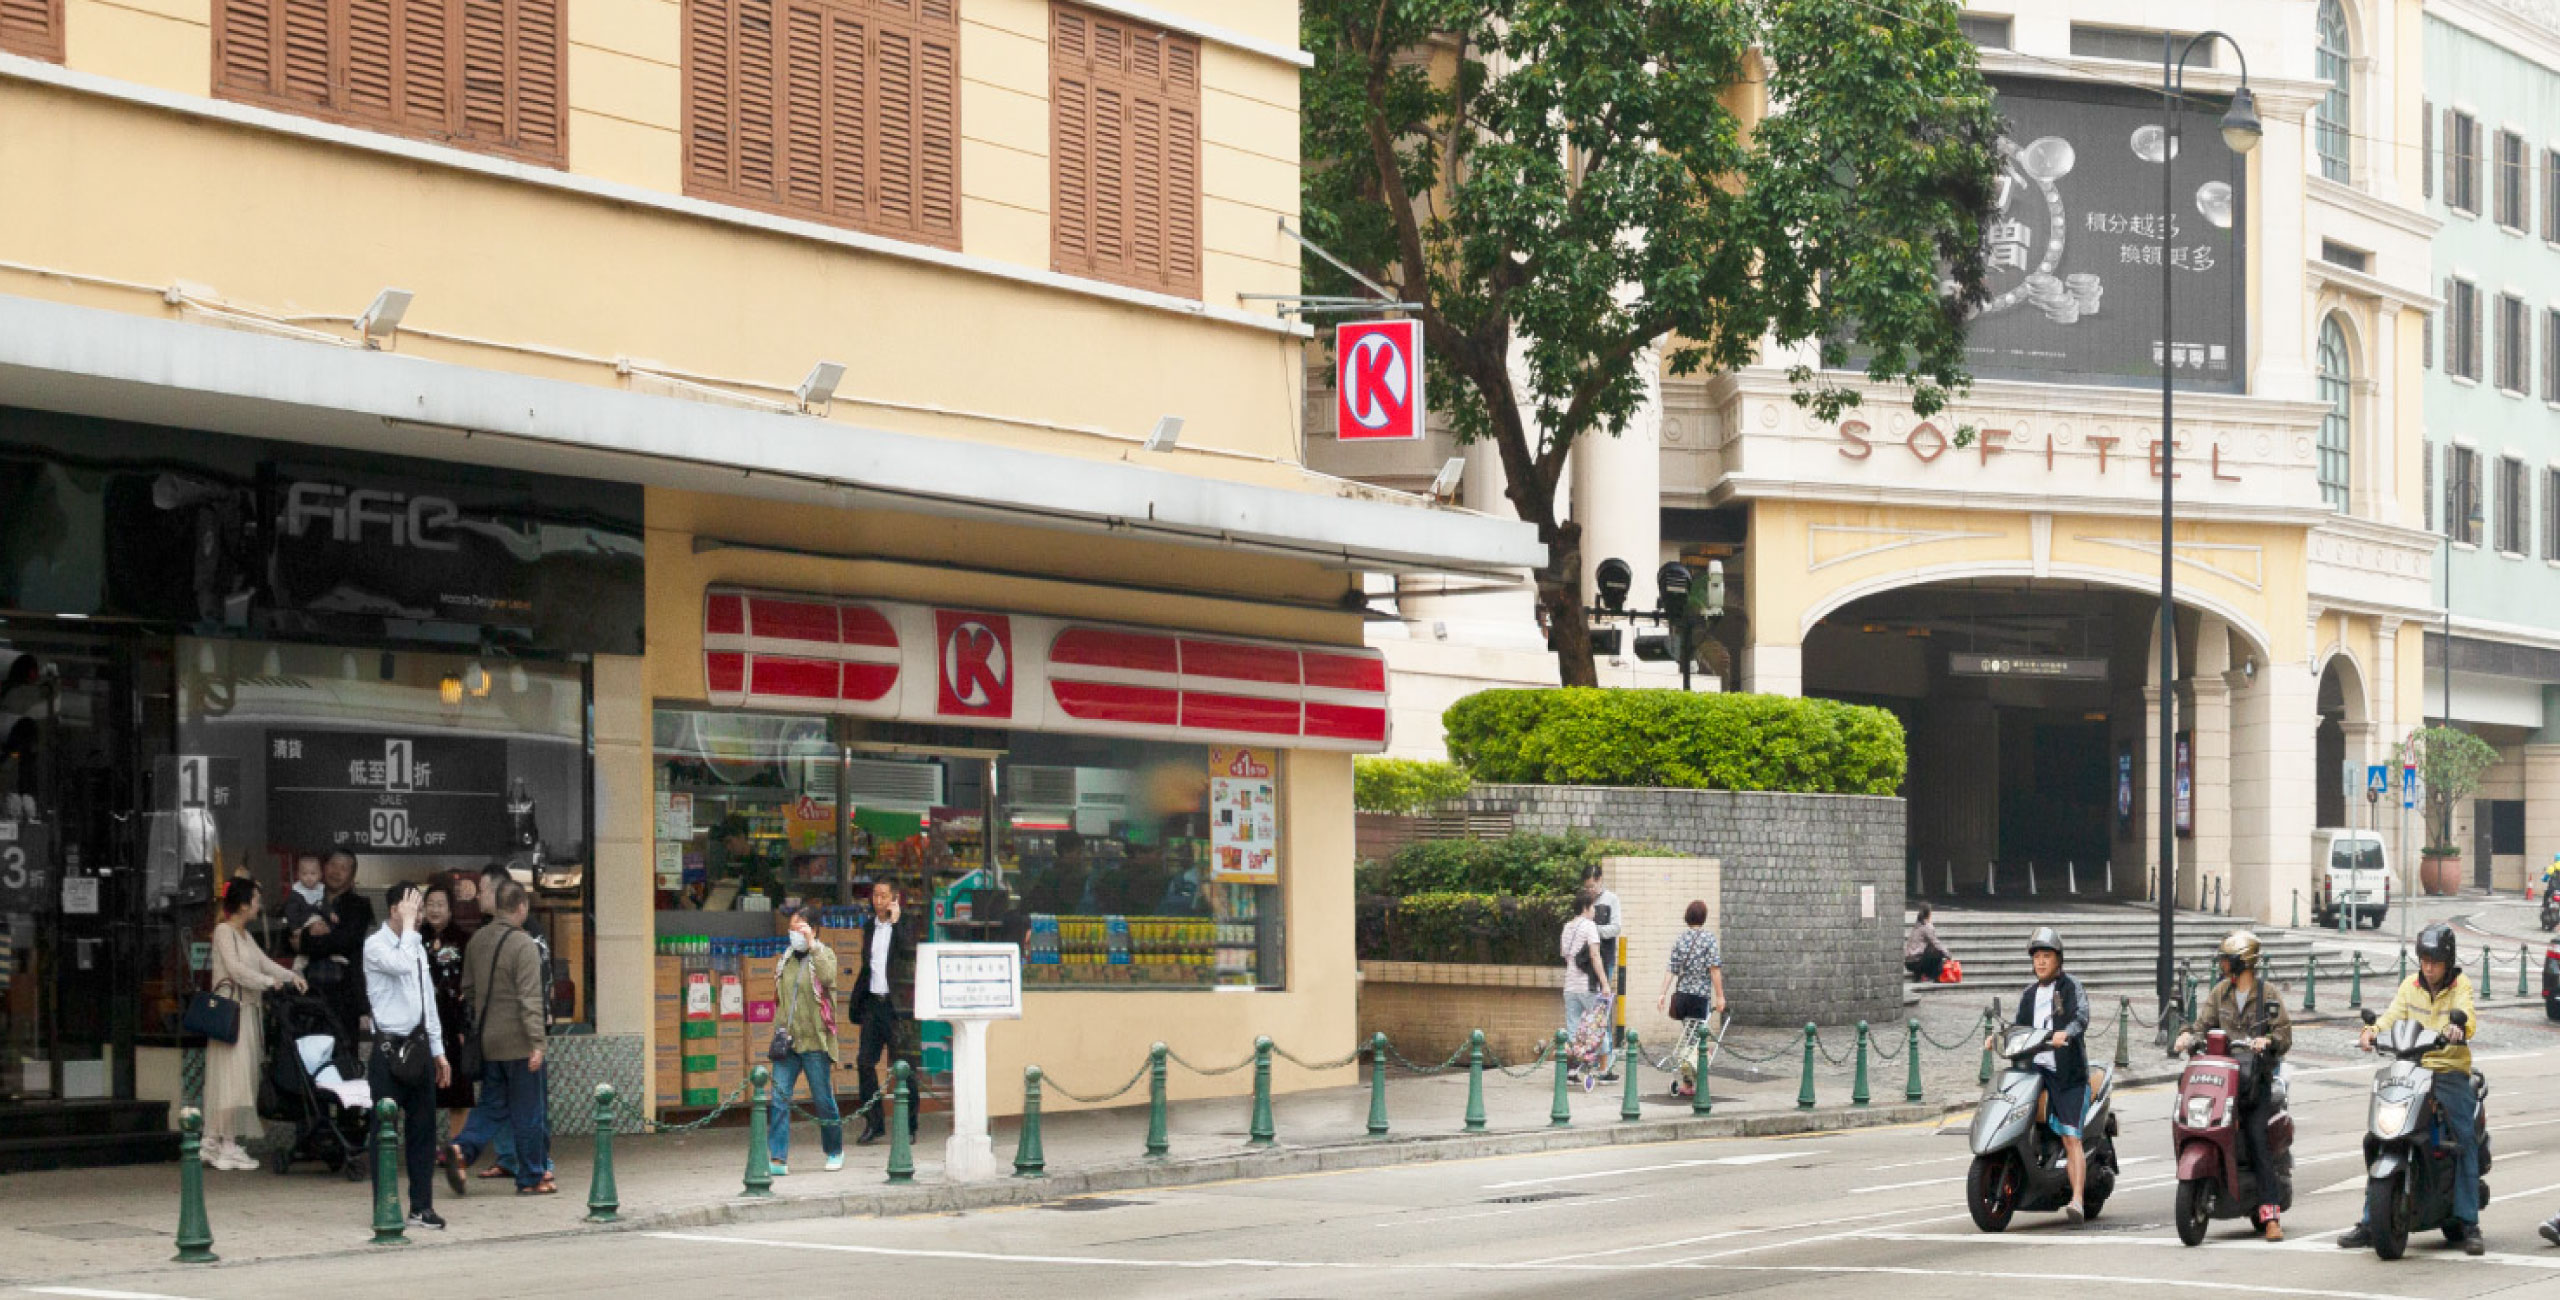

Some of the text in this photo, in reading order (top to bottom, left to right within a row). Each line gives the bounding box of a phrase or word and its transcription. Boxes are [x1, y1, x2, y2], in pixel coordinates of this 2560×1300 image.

[1345, 332, 1407, 429] K
[1839, 419, 2241, 483] SOFITEL
[945, 621, 1006, 706] K
[333, 831, 350, 844] UP
[354, 831, 369, 844] TO
[423, 833, 447, 845] OFF
